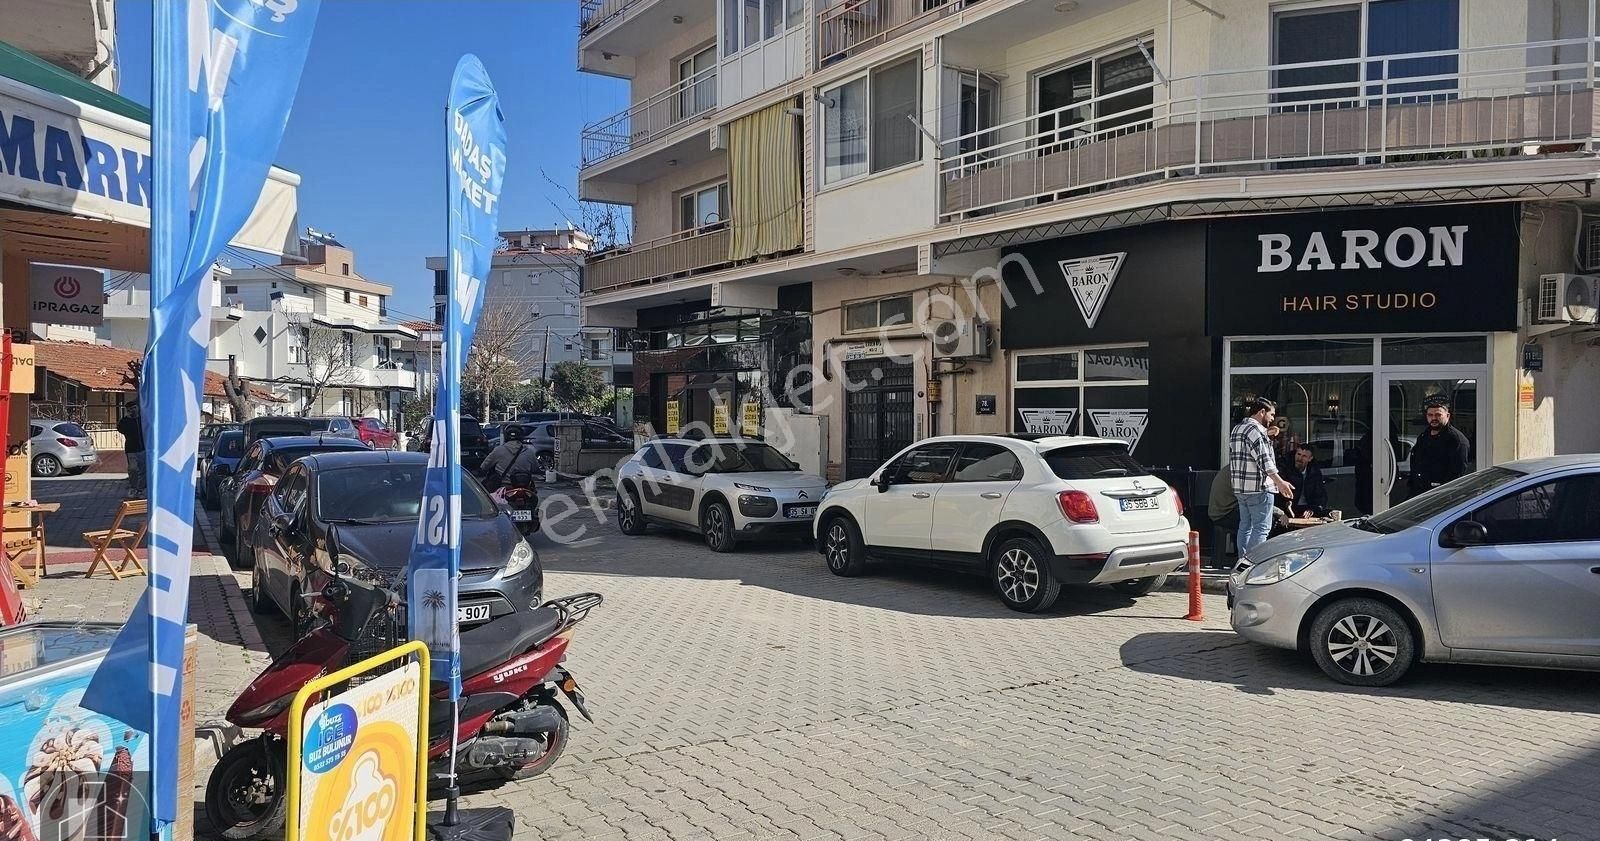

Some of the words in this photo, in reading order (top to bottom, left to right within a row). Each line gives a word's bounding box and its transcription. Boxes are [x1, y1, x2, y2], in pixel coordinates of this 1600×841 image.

[1257, 225, 1469, 272] BARON
[1072, 273, 1109, 286] BARON
[1283, 295, 1337, 311] HAIR
[1345, 292, 1436, 310] STUDIO
[1101, 427, 1139, 438] BARON
[466, 606, 488, 619] 907
[318, 722, 344, 748] ICE
[308, 748, 322, 764] BUZ
[323, 735, 352, 756] BULUNUR
